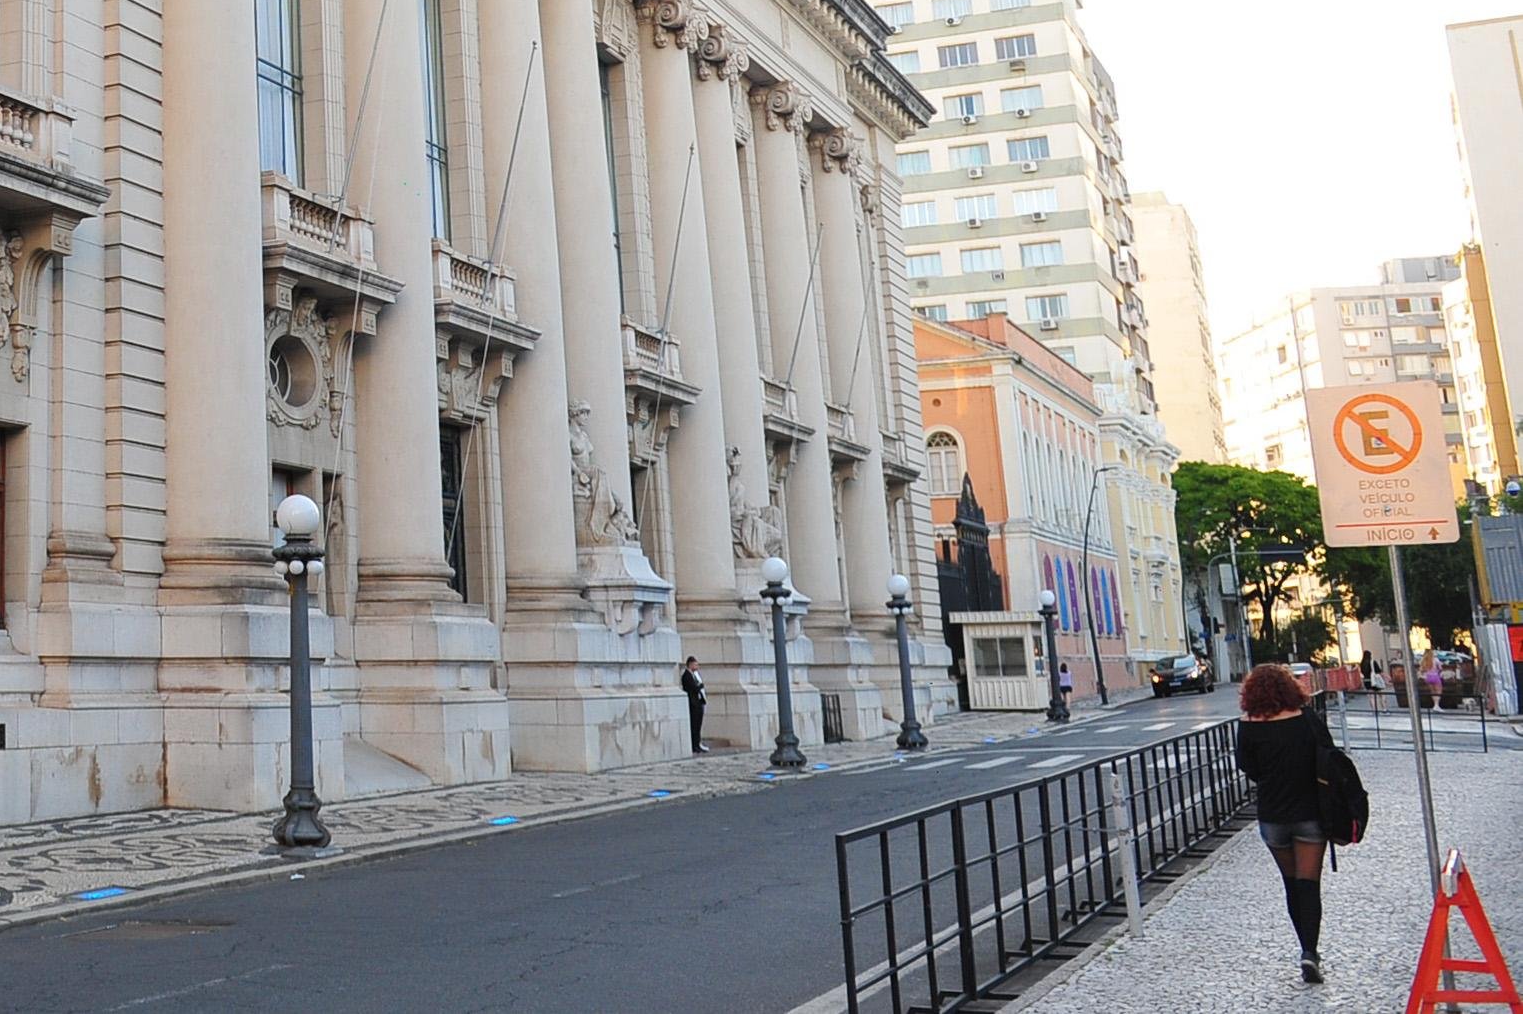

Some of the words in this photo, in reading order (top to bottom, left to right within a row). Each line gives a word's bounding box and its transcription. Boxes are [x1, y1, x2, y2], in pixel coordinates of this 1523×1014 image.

[1358, 478, 1410, 490] EXCETO
[1359, 492, 1415, 504] VEÍCULO
[1367, 527, 1415, 541] INÍCIO
